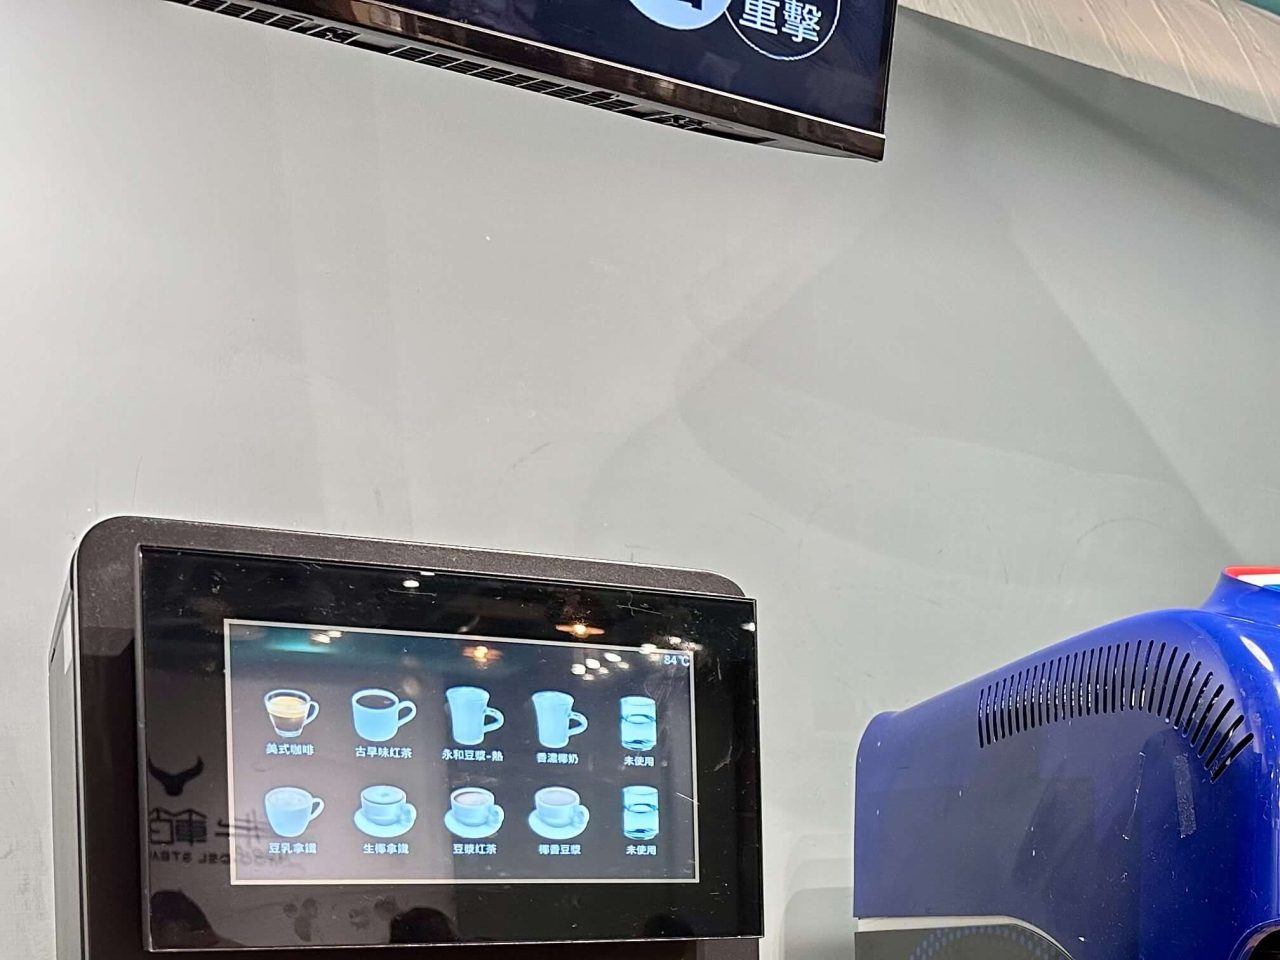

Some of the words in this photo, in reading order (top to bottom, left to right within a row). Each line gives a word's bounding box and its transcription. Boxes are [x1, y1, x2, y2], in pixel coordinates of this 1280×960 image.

[739, 0, 822, 43] 重擊
[266, 743, 315, 756] 美式咖啡
[355, 746, 412, 759] 古早味紅茶
[623, 756, 655, 767] 未使用
[625, 845, 657, 856] 未使用
